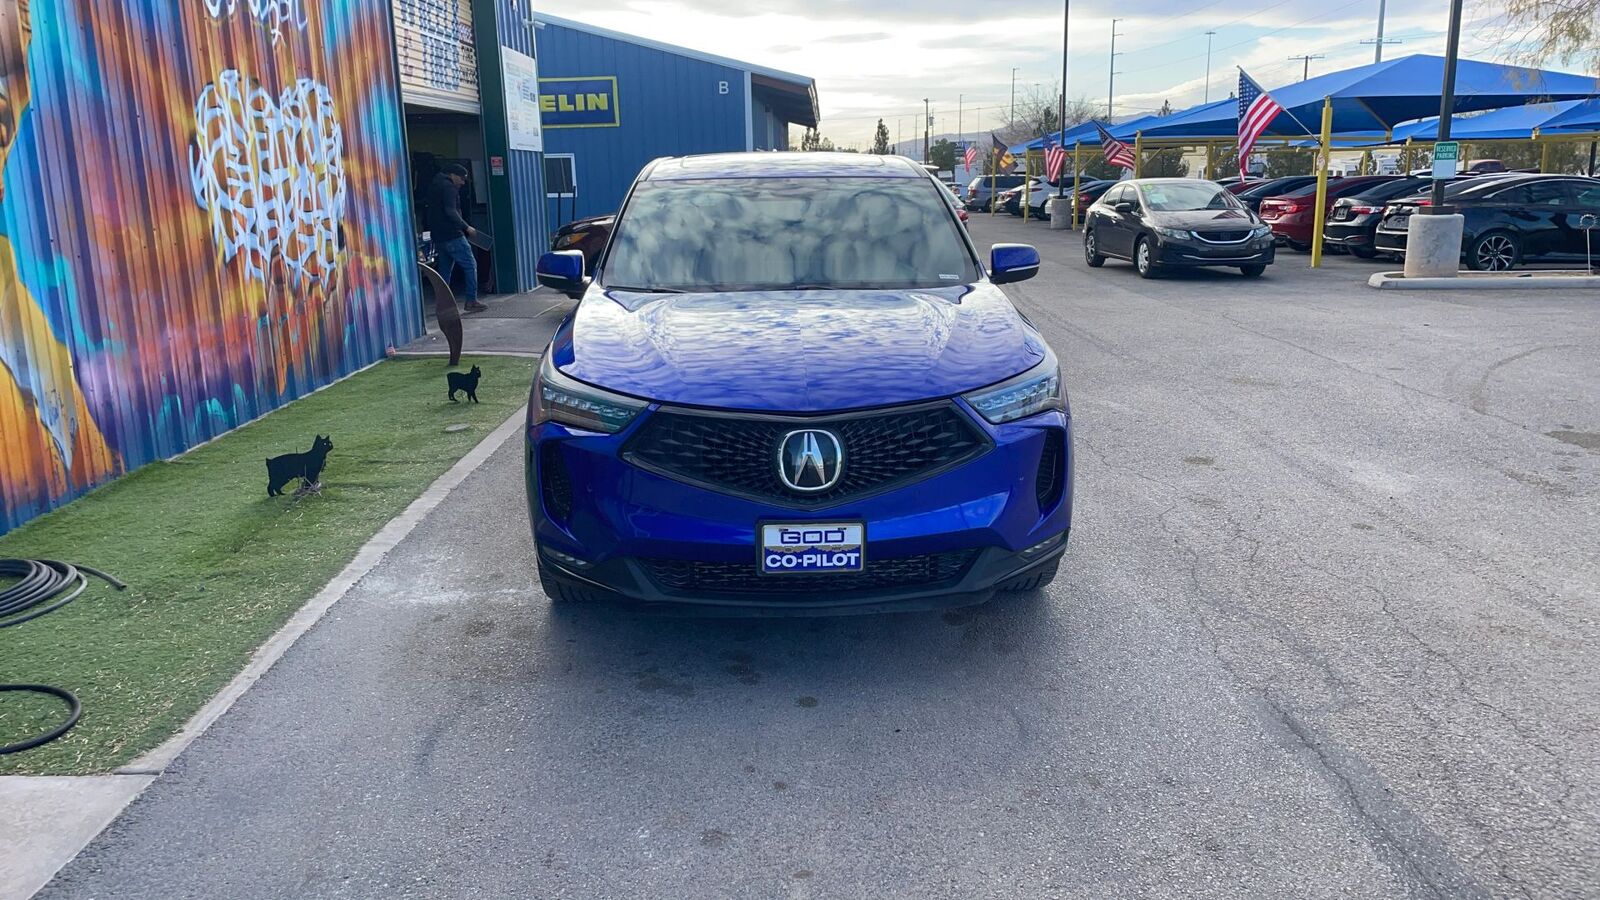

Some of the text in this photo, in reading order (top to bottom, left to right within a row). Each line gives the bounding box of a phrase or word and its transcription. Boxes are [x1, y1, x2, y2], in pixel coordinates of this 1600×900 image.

[719, 81, 729, 94] B
[780, 530, 845, 544] GOD
[766, 553, 859, 568] CO-PILOT
